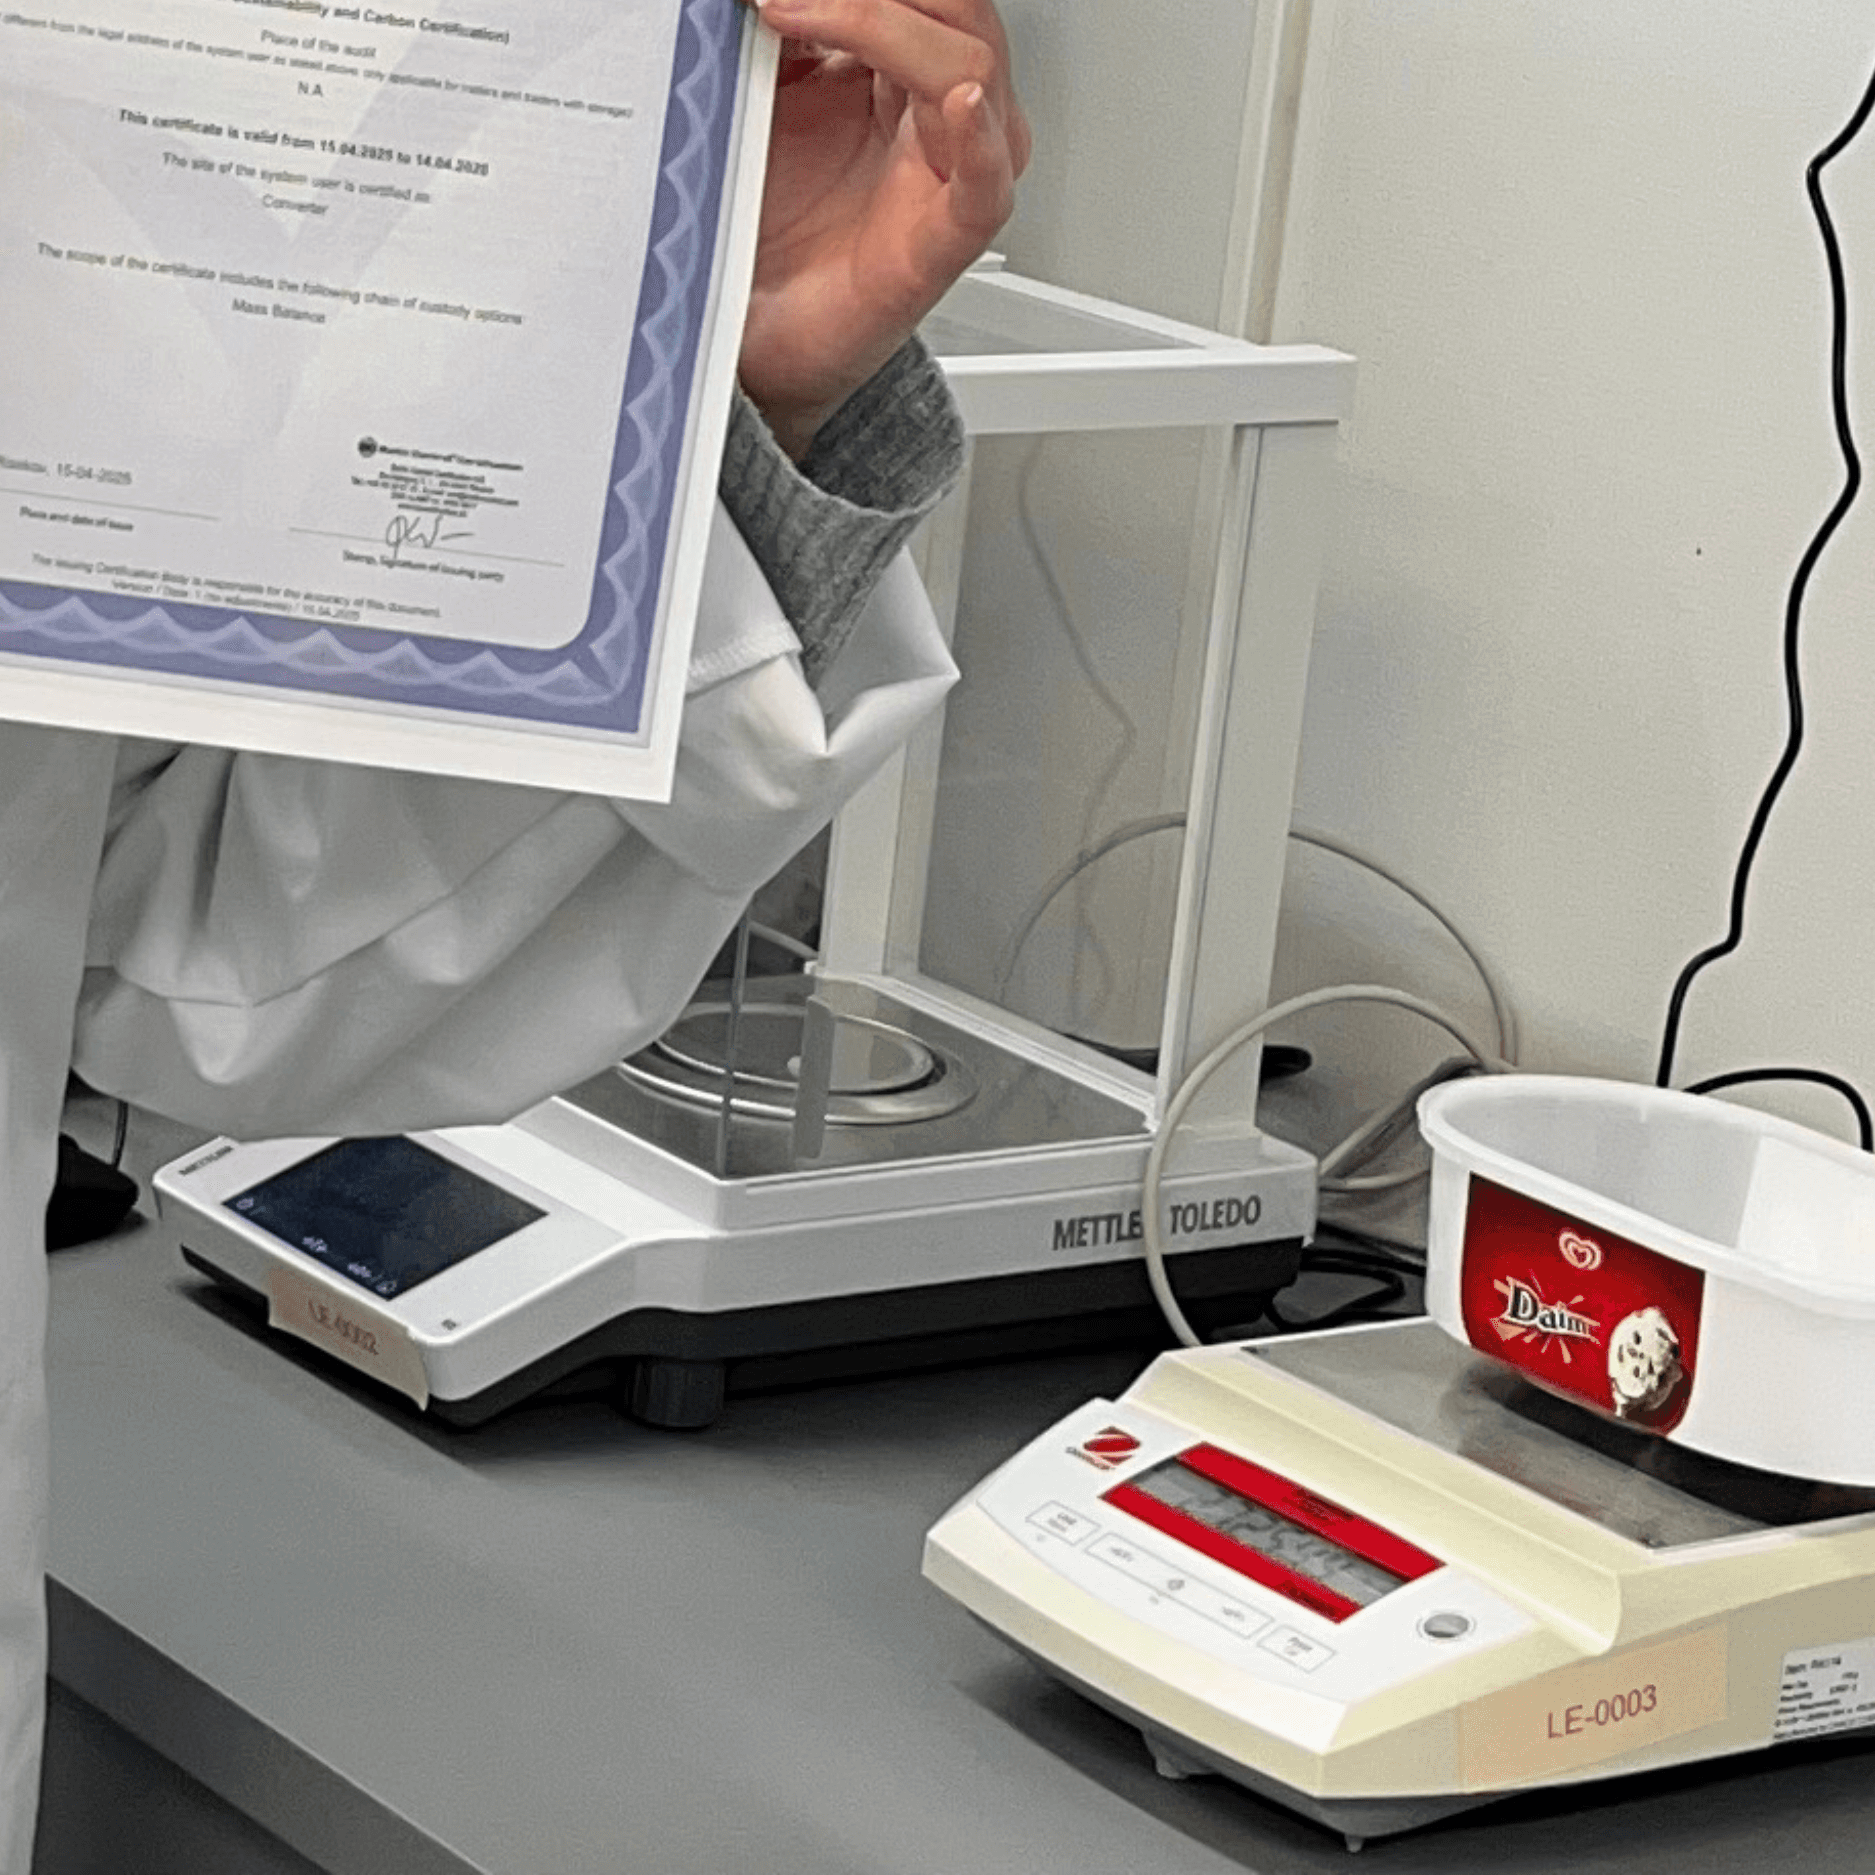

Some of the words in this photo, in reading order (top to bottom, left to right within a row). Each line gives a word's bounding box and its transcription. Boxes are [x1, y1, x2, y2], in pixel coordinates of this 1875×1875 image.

[119, 108, 148, 125] This
[162, 151, 188, 168] The
[37, 241, 63, 258] The
[1052, 1210, 1144, 1251] METTLE
[1169, 1194, 1262, 1235] TOLEDO
[1507, 1277, 1589, 1336] Daim
[1547, 1683, 1658, 1739] LE-0003
